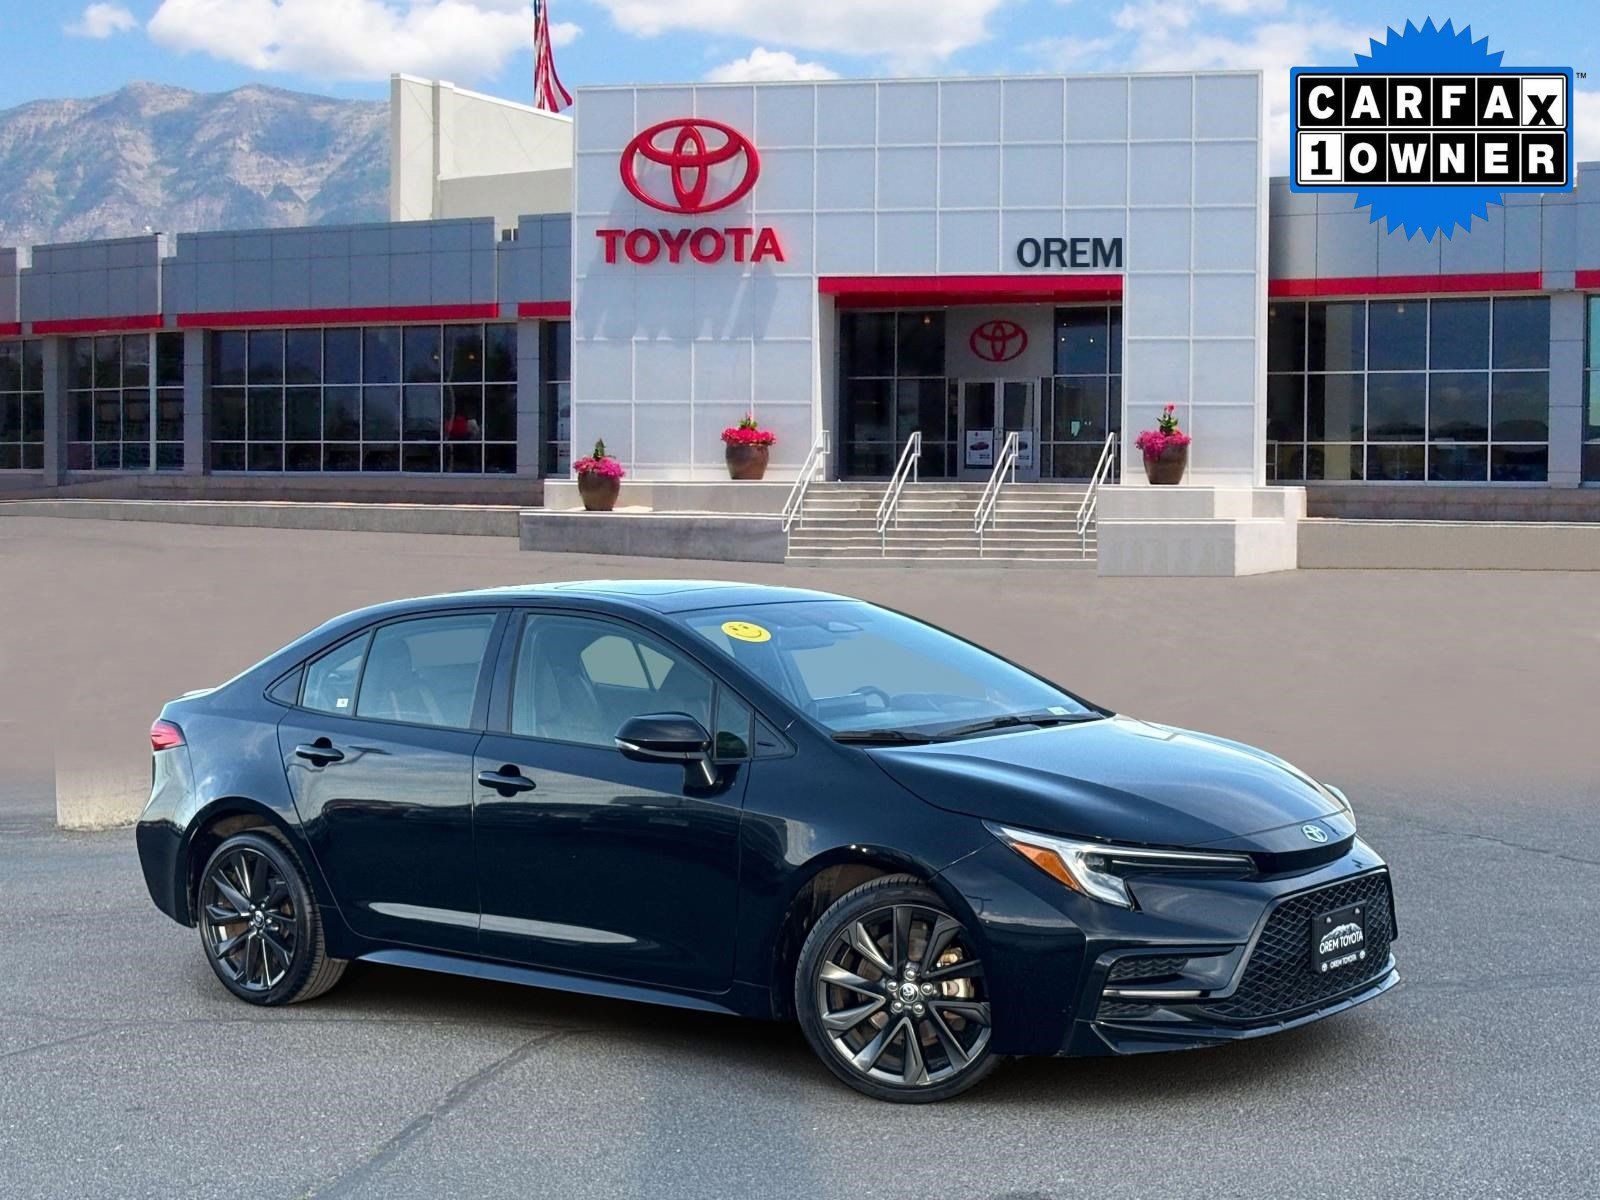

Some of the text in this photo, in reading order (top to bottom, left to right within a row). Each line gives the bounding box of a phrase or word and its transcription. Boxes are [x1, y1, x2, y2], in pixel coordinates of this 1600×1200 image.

[595, 227, 785, 265] TOYOTA
[1017, 237, 1123, 268] OREM
[1319, 930, 1363, 954] OREM TOYOTA
